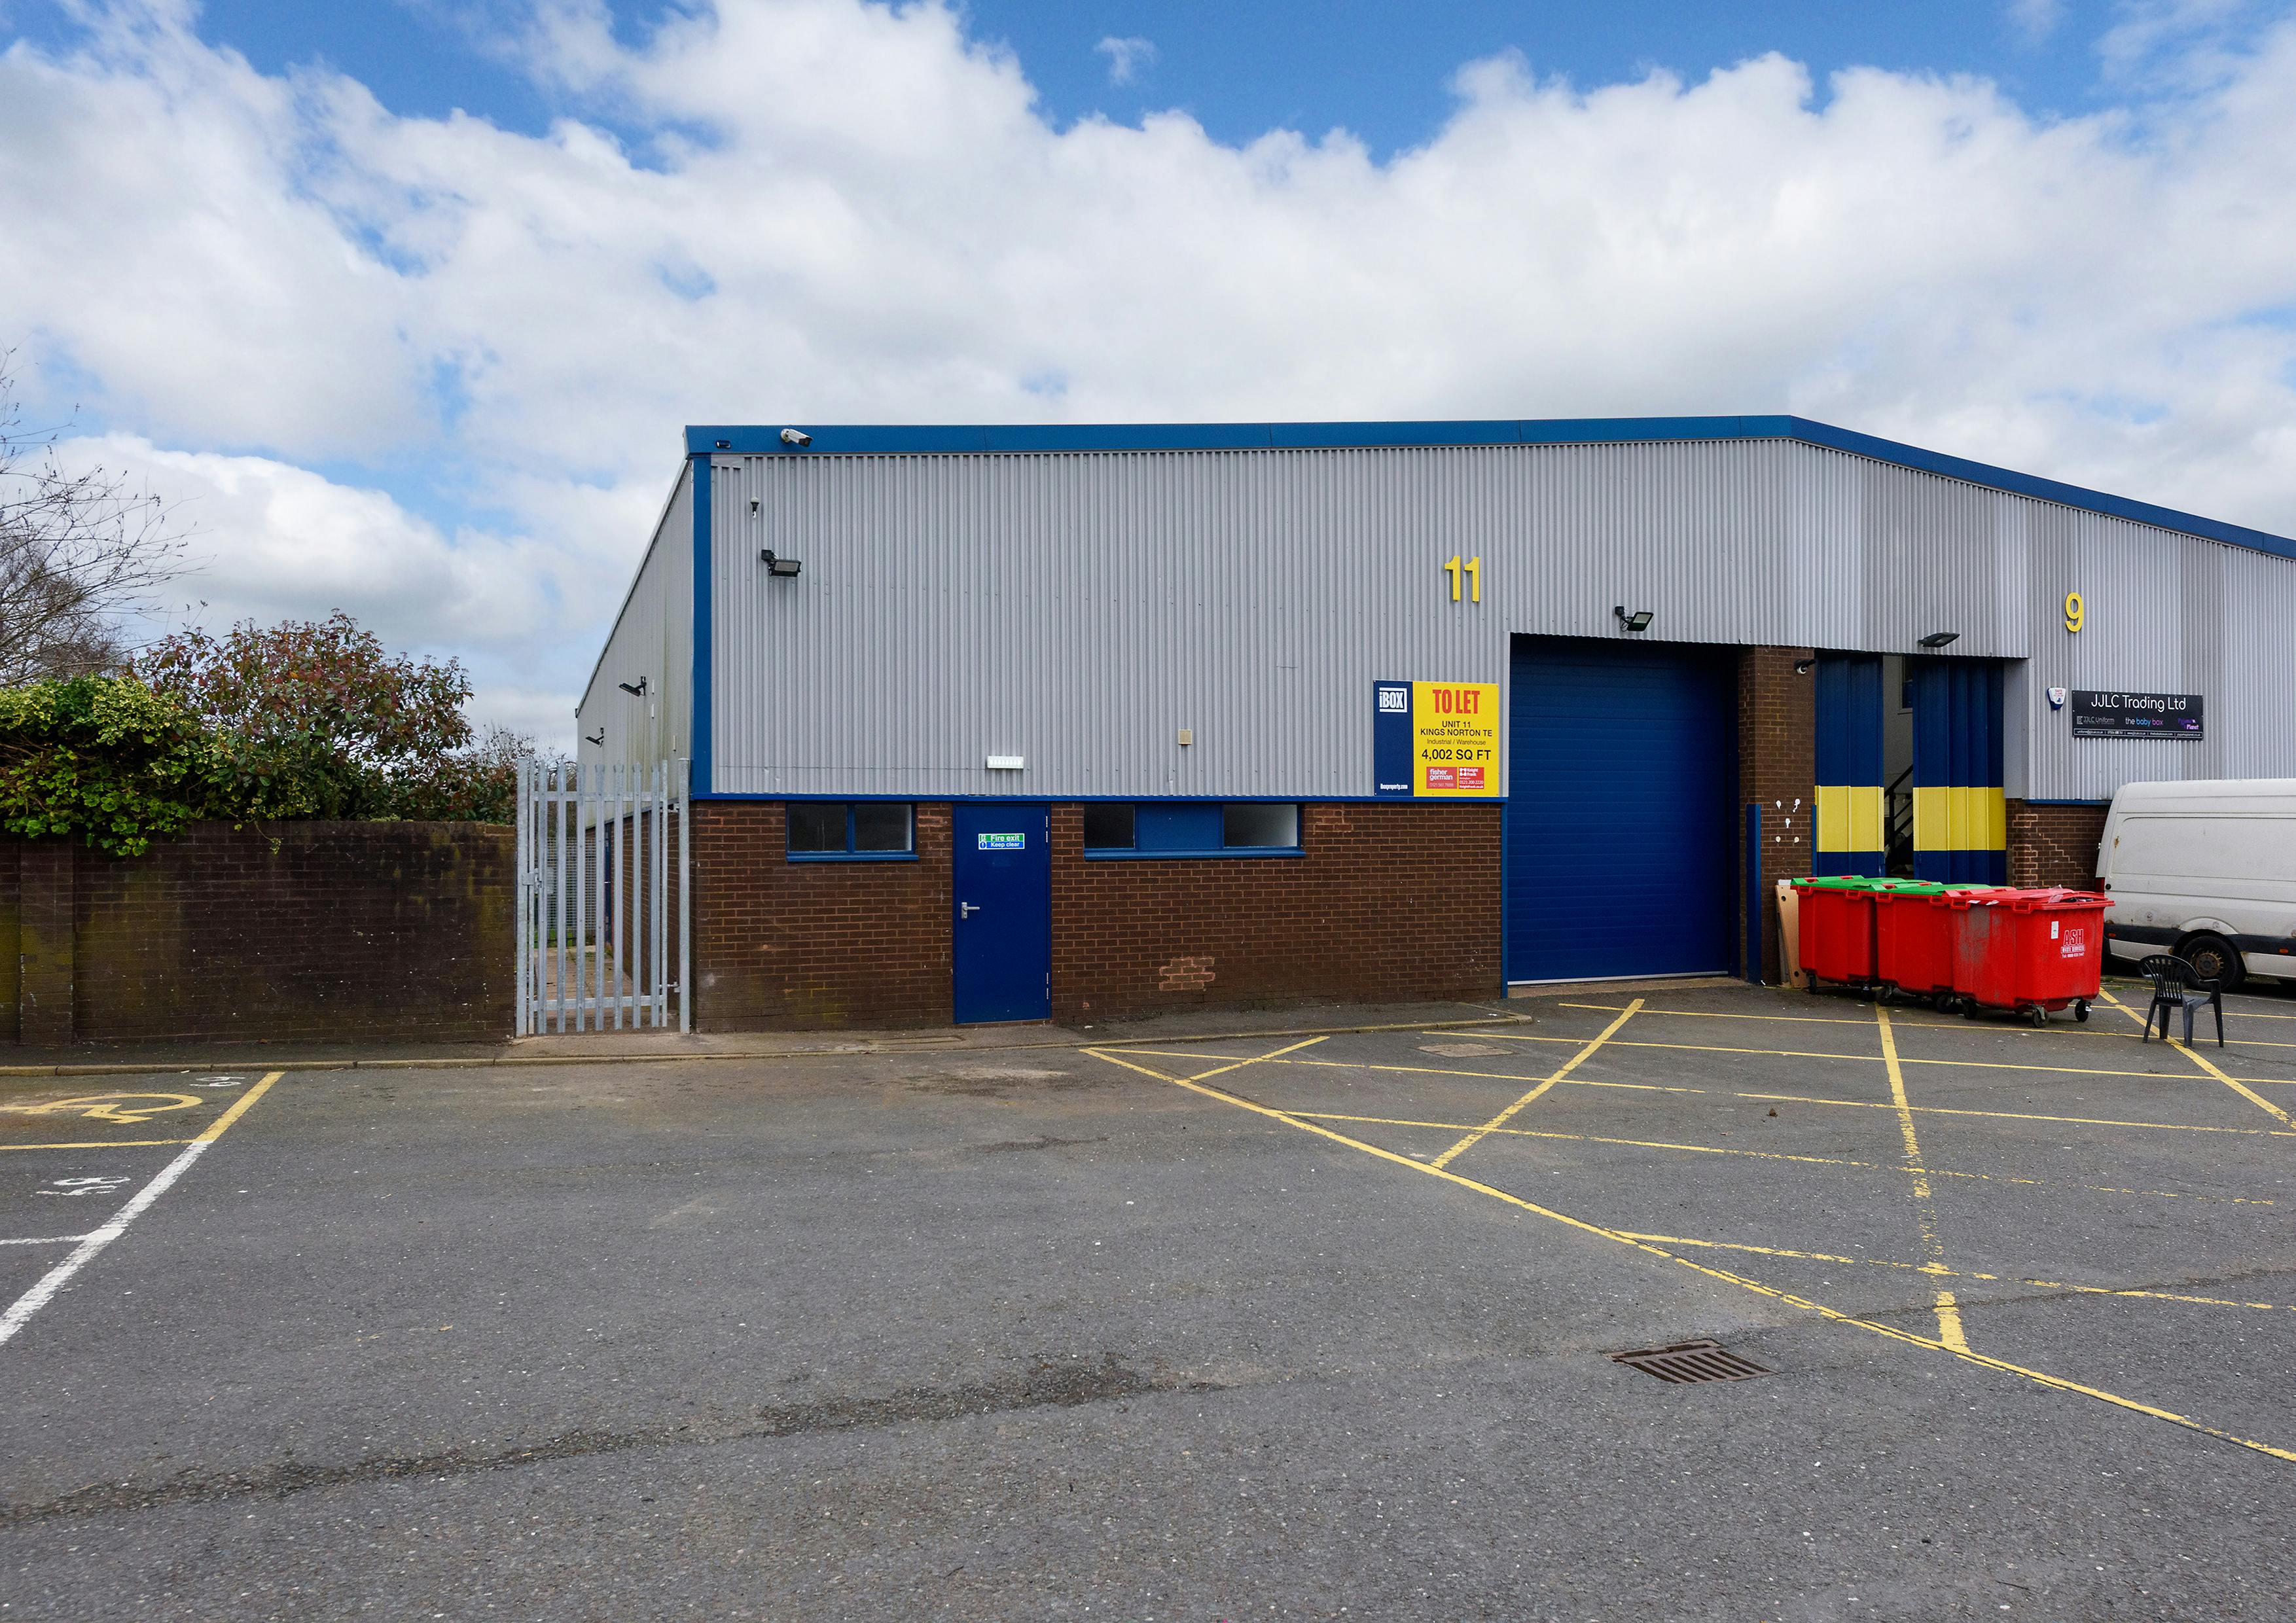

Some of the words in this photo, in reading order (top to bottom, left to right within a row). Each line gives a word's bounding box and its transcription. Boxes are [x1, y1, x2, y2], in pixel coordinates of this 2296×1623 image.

[1444, 555, 1480, 602] 11
[2065, 592, 2084, 632] 9
[1379, 691, 1404, 709] iBOX
[1432, 689, 1452, 714] TO
[1456, 690, 1480, 714] LET
[2091, 694, 2119, 708] JJLC
[2122, 695, 2165, 712] Trading
[2168, 697, 2186, 710] Ltd
[2136, 717, 2151, 727] baby
[1422, 749, 1452, 761] 4,002
[1456, 749, 1473, 760] SQ
[1477, 750, 1491, 760] FT
[2063, 929, 2084, 946] ASH
